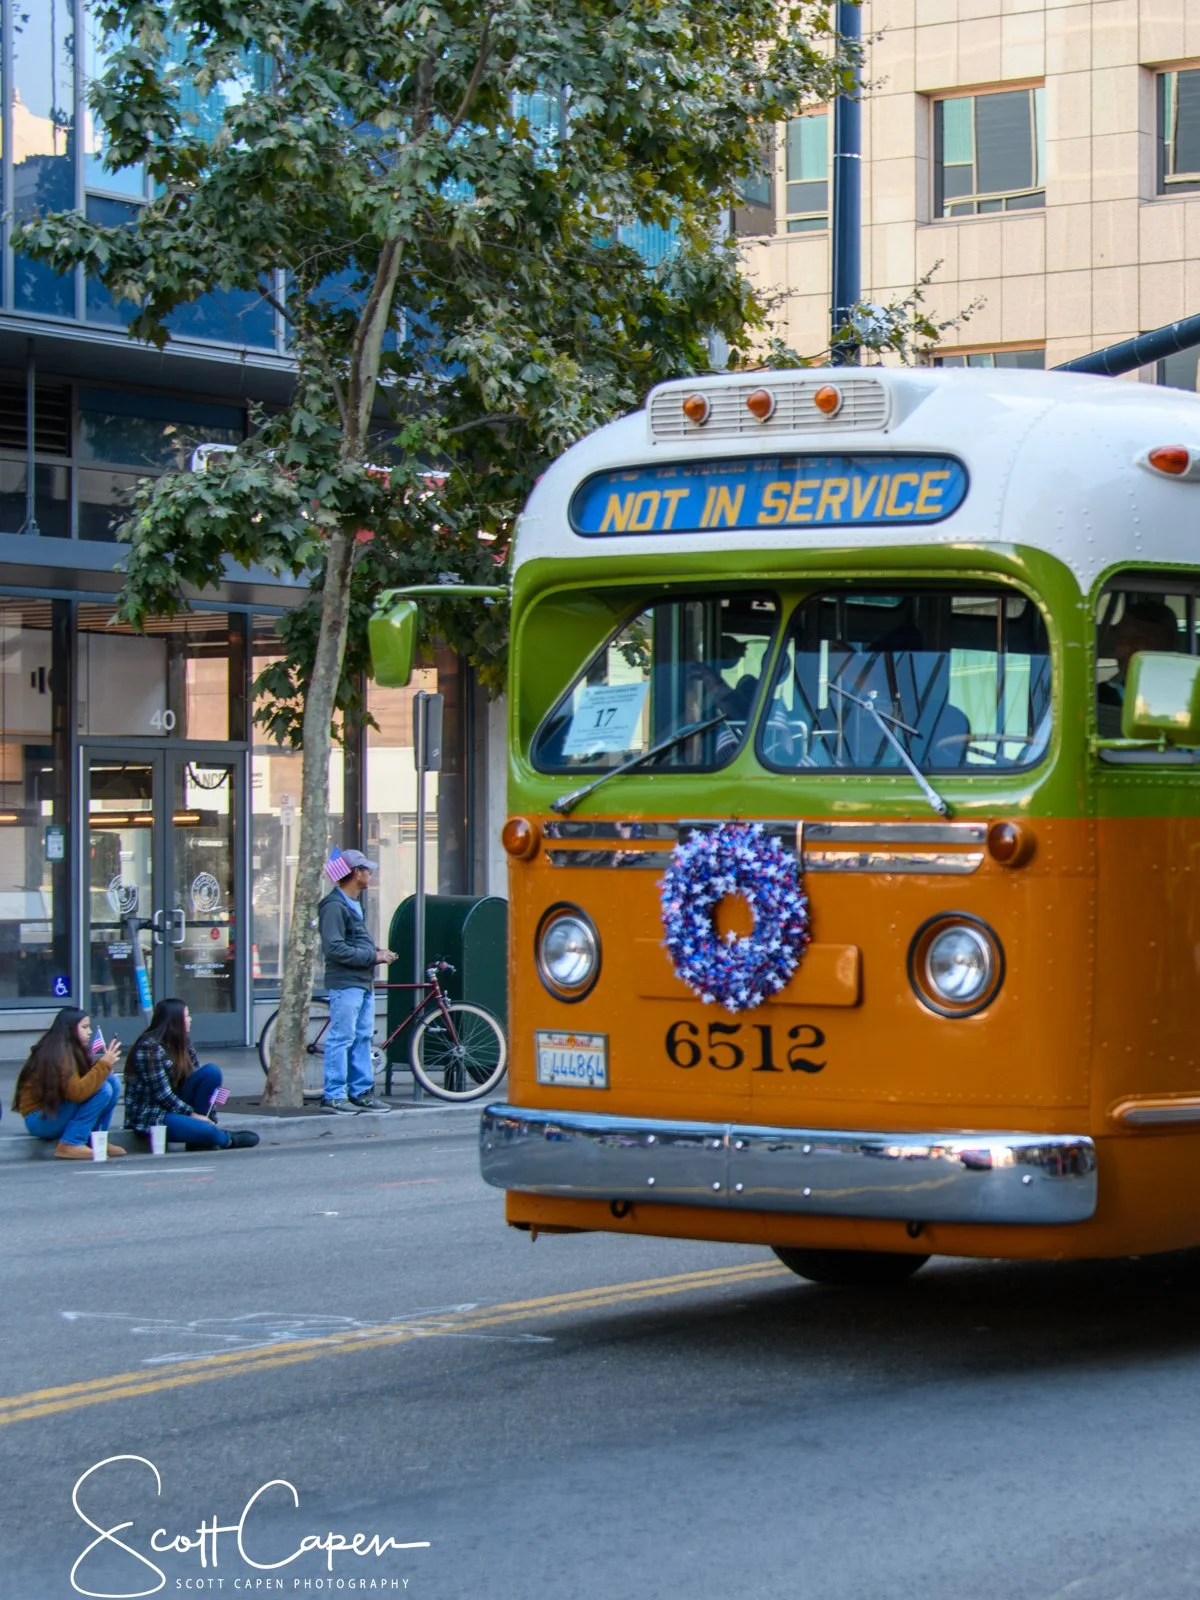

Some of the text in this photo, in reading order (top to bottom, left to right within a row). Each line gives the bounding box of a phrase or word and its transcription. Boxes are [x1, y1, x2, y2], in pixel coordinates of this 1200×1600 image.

[599, 470, 950, 532] NOT IN SERVICE
[150, 709, 177, 730] 40
[593, 707, 618, 728] 17
[665, 1020, 827, 1073] 6512
[552, 1052, 604, 1078] 444864
